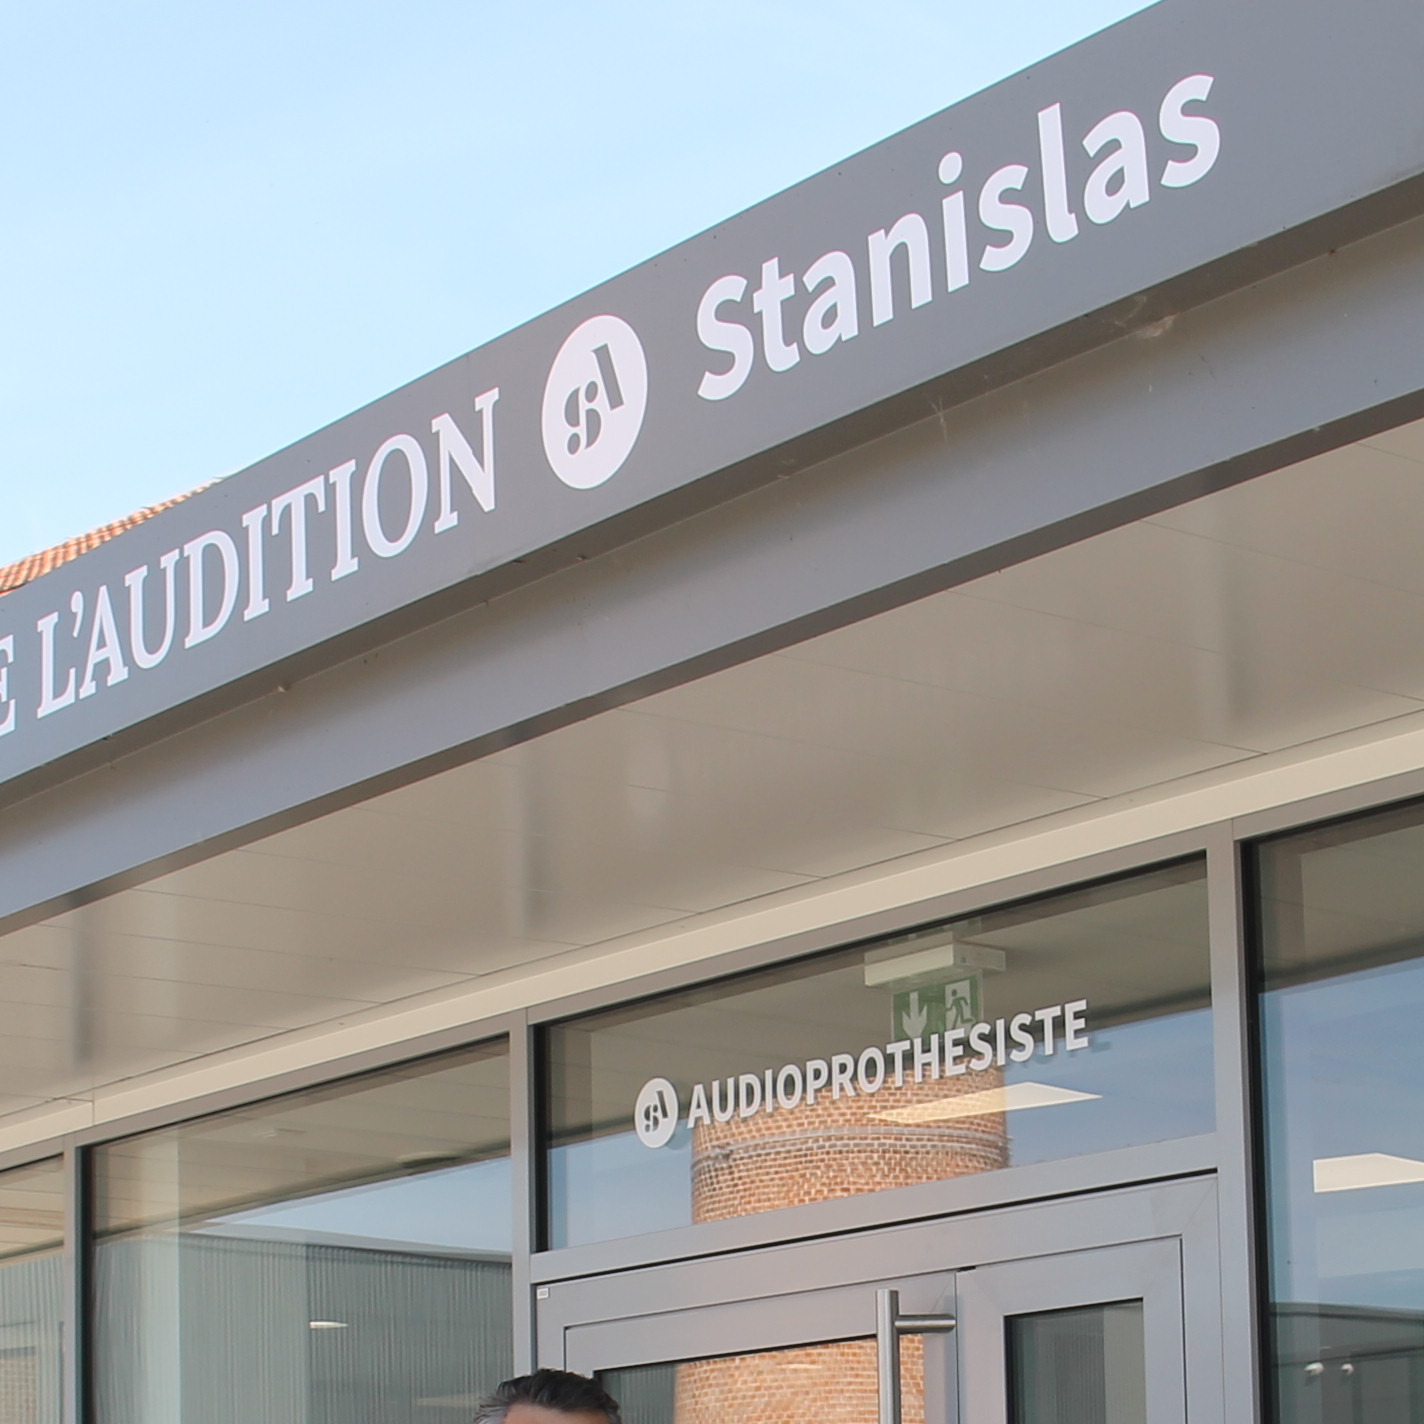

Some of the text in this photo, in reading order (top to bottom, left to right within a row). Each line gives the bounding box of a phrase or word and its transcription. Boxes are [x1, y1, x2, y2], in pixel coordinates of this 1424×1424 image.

[36, 387, 499, 720] L'AUDITION
[696, 74, 1222, 401] Stanislas
[686, 999, 1089, 1129] AUDIOPROTHESISTE
